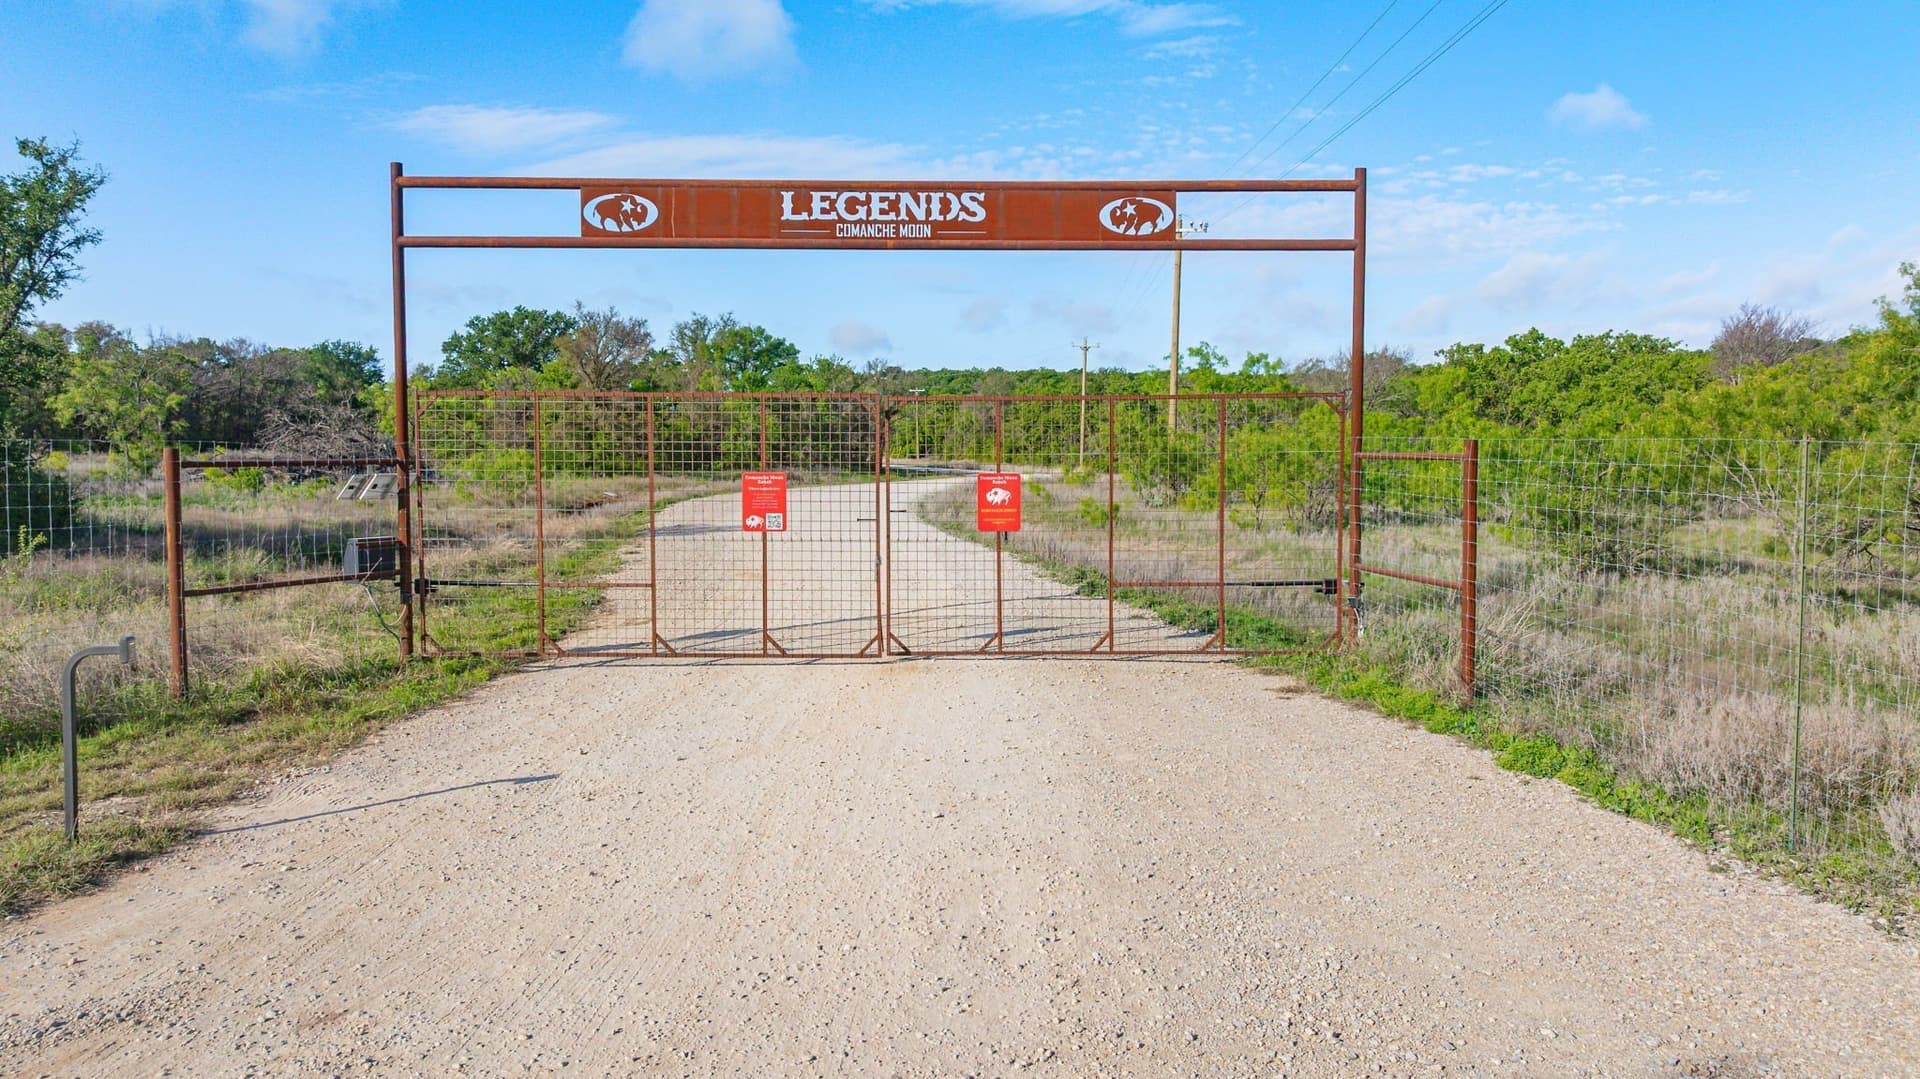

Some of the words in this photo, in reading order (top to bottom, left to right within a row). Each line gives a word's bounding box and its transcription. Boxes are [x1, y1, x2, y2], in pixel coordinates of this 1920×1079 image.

[780, 191, 987, 222] LEGENDS
[836, 223, 896, 238] COMANCHE
[899, 224, 931, 238] MOON
